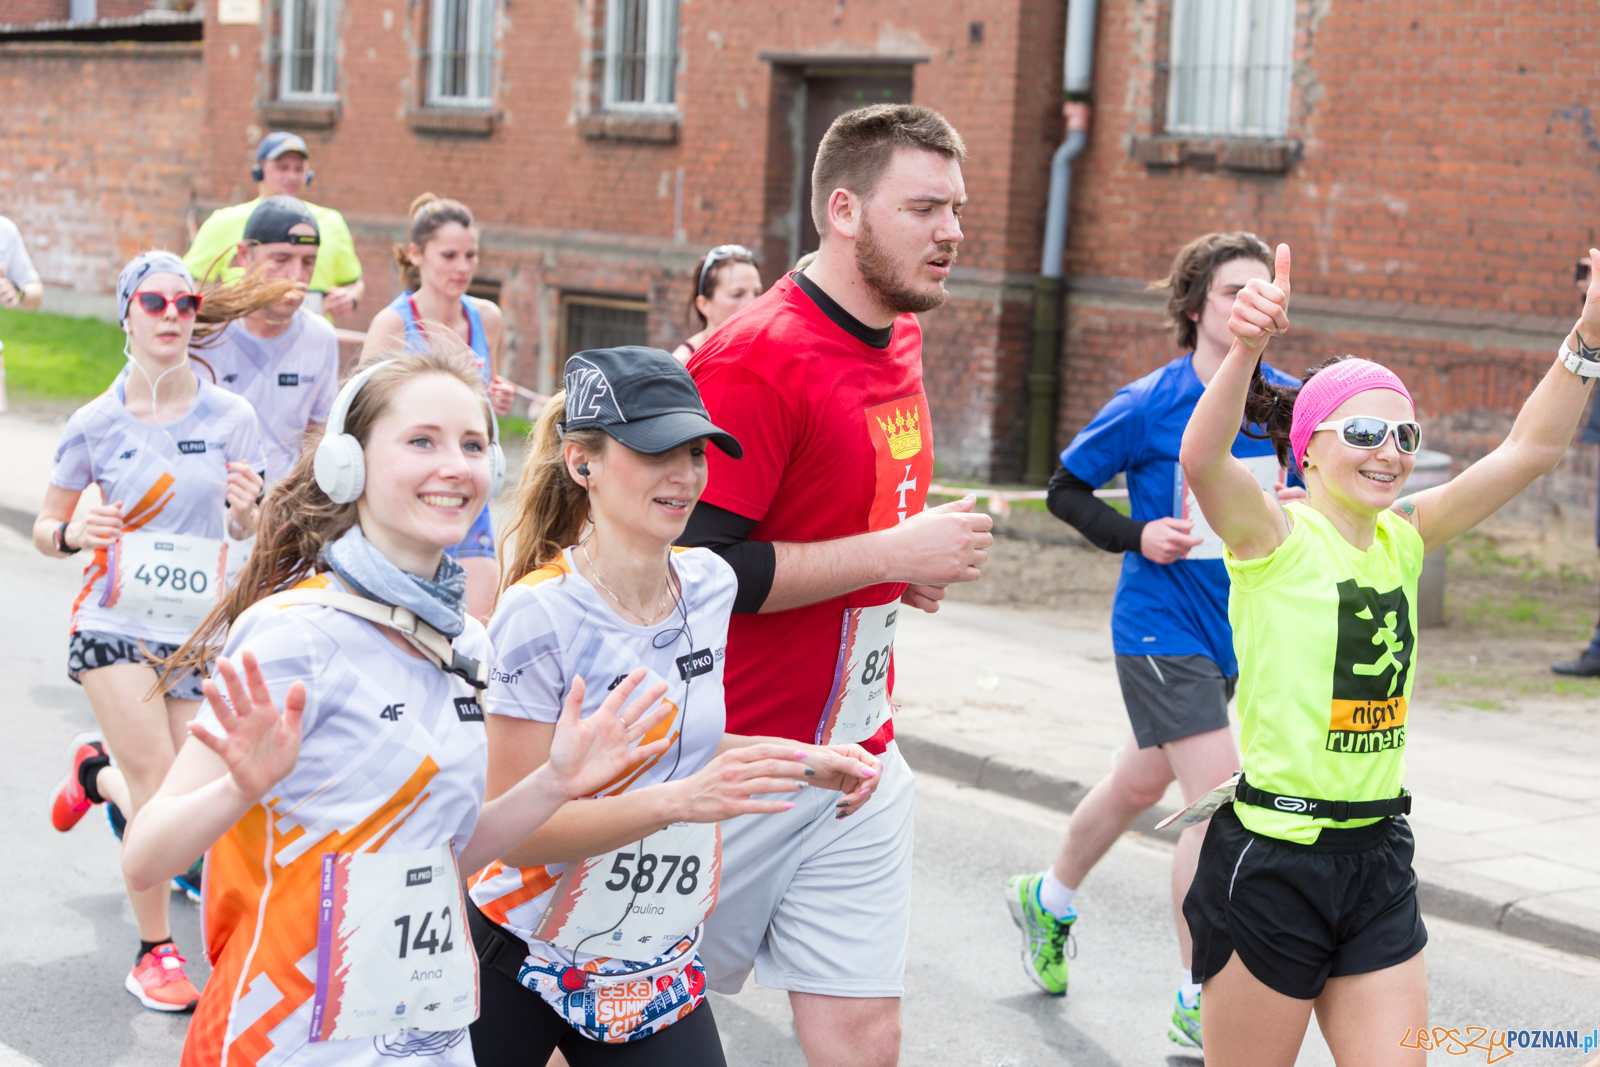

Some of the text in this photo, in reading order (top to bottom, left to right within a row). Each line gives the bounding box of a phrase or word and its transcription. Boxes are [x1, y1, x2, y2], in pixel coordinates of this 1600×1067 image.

[134, 564, 208, 594] 4980
[380, 703, 405, 721] 4F
[459, 703, 482, 716] 11.PK
[1327, 726, 1406, 752] runners
[410, 870, 432, 882] 11.PKO
[605, 852, 701, 896] 5878
[322, 899, 332, 908] D
[625, 902, 665, 915] Paulina
[394, 906, 453, 959] 142
[410, 969, 443, 982] Anna
[600, 982, 650, 998] eska
[599, 1000, 651, 1022] SUMM
